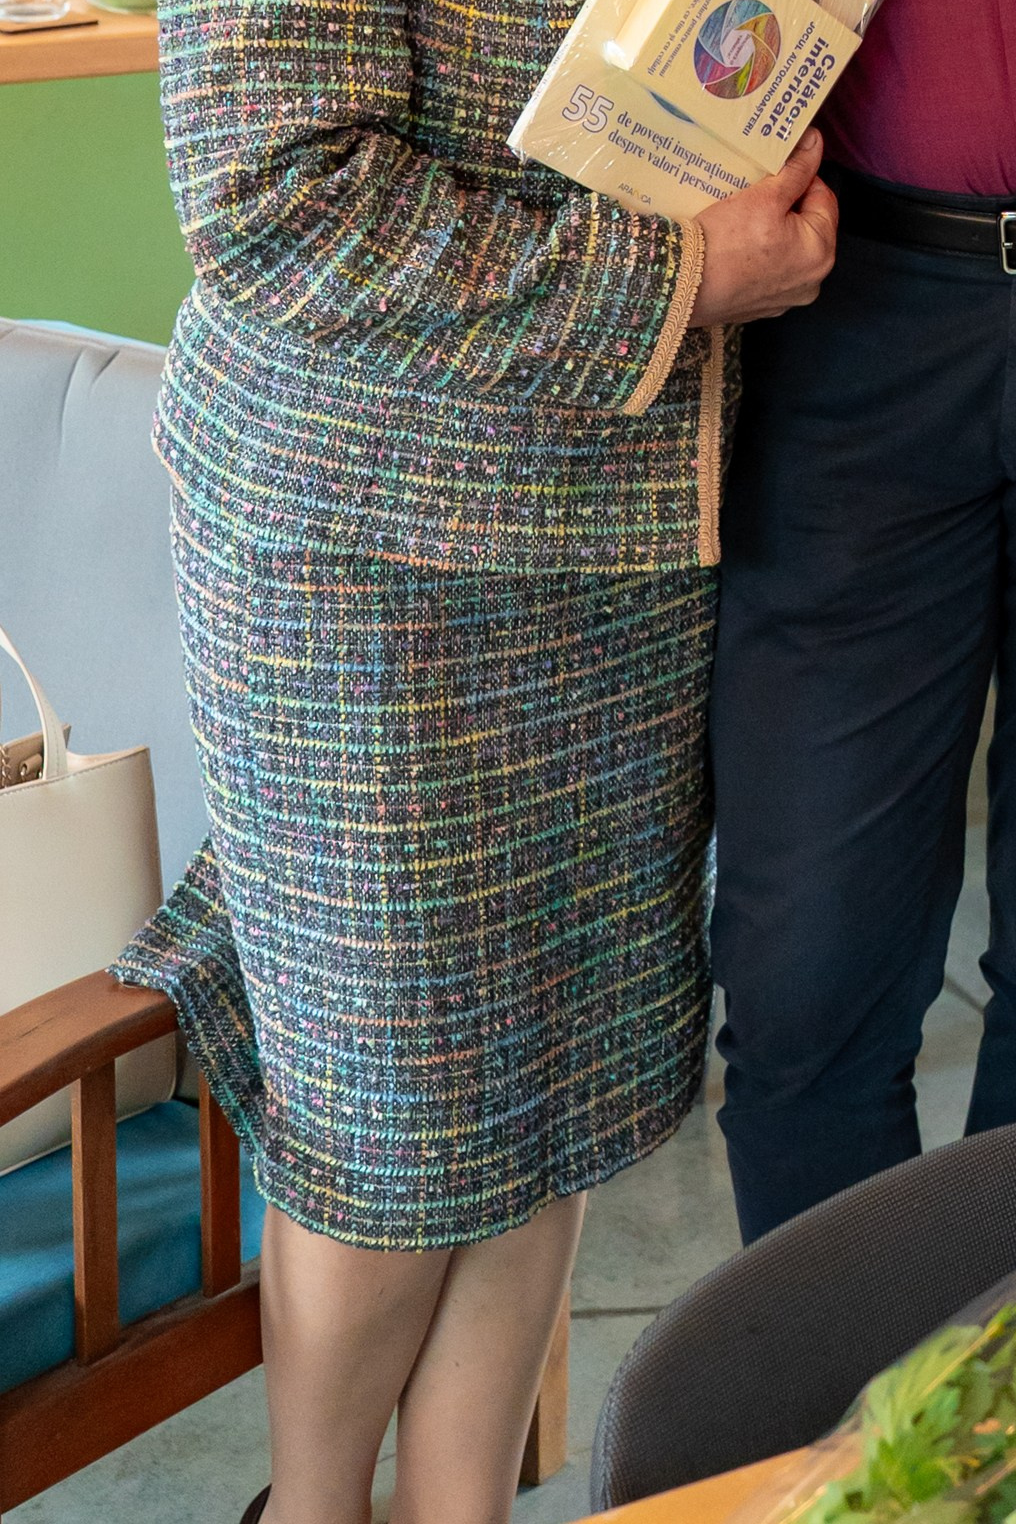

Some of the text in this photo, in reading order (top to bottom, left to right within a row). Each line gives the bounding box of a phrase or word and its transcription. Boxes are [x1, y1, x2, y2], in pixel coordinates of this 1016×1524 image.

[675, 19, 686, 34] tine
[681, 18, 698, 44] pentru
[683, 10, 691, 19] cu
[663, 41, 671, 51] cu
[794, 21, 816, 50] JOCUL
[761, 37, 829, 136] interioare
[776, 54, 836, 142] Călătorii
[561, 83, 615, 133] 55
[608, 129, 646, 158] despre
[648, 152, 682, 177] valori
[617, 111, 751, 190] de povești inspiraționale
